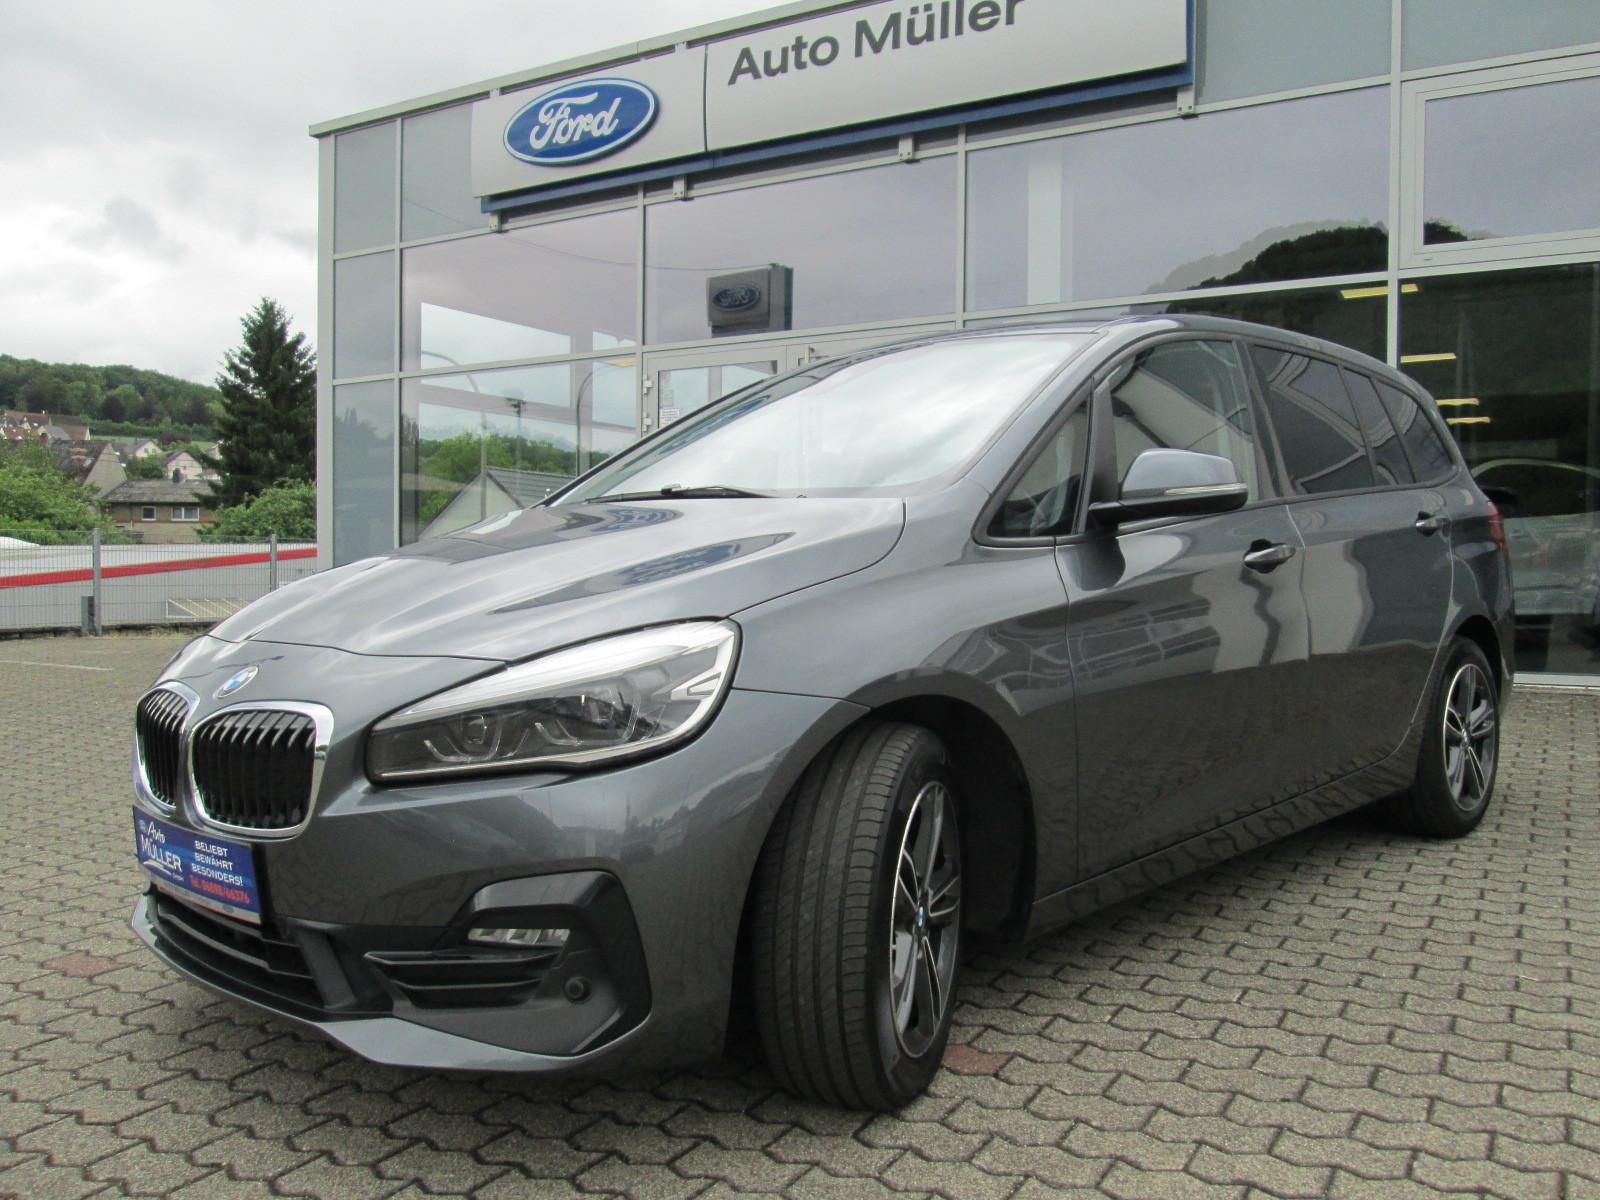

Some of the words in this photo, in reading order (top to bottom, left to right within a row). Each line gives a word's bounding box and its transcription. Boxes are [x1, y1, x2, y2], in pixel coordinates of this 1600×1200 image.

[727, 35, 840, 86] Auto
[854, 0, 1026, 58] Müller
[529, 91, 623, 150] Ford
[147, 821, 166, 844] Auto
[141, 834, 183, 873] MÜLLER
[194, 840, 228, 857] BELIEBT
[191, 863, 244, 887] BESONDERS!
